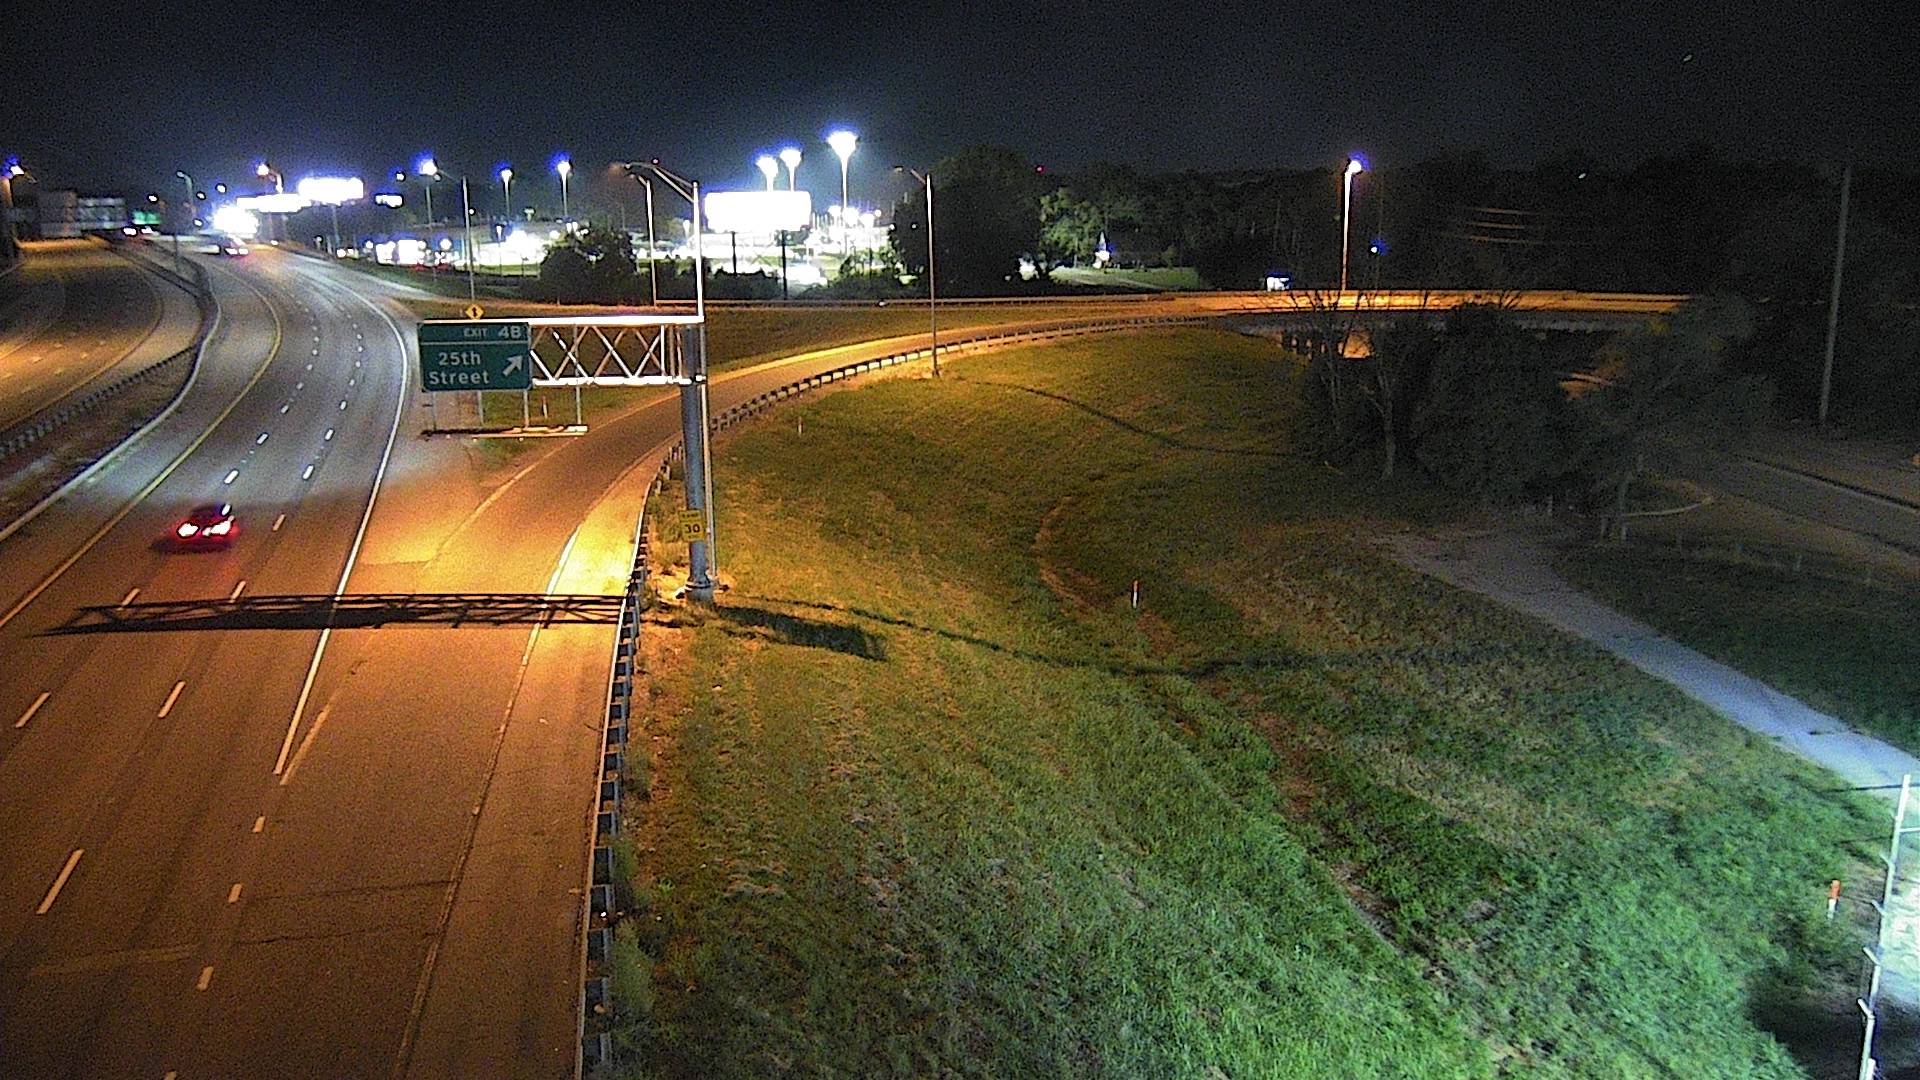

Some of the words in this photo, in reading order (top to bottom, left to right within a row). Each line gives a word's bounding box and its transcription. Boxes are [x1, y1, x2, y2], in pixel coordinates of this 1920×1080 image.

[463, 327, 488, 337] EXIT
[498, 325, 521, 339] 4B
[438, 351, 481, 366] 25th
[429, 370, 490, 385] Street
[684, 523, 700, 533] 30
